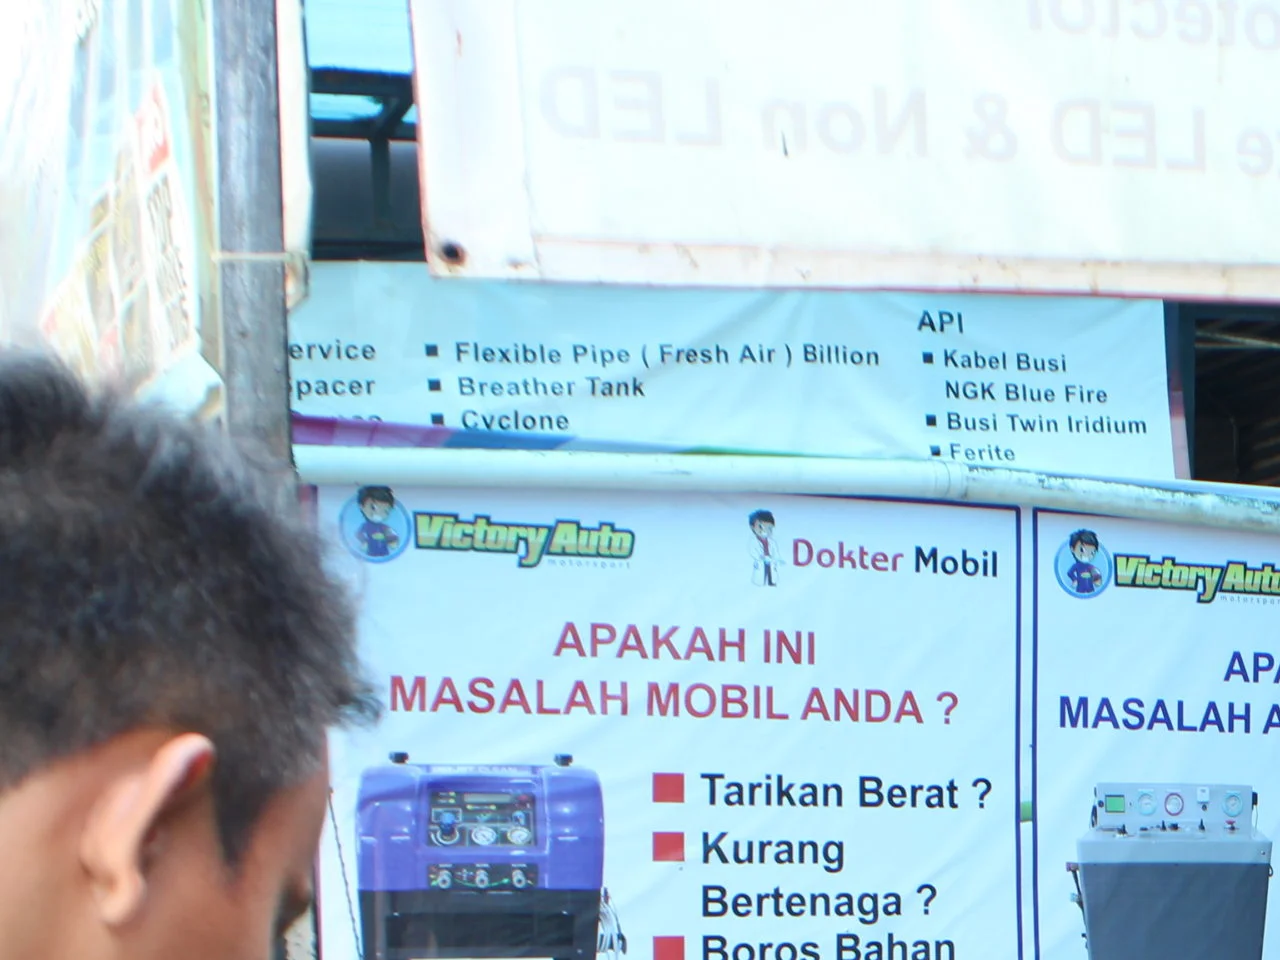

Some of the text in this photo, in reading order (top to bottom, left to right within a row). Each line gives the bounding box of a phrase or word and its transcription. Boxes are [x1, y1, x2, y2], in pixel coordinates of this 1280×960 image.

[917, 310, 964, 334] API
[288, 339, 376, 359] ervice
[455, 341, 562, 364] Flexible
[573, 344, 631, 367] Pipe
[659, 344, 729, 365] Fresh
[739, 344, 776, 365] Air
[803, 344, 880, 366] Billion
[944, 349, 1067, 373] Kabel Busi
[290, 379, 376, 401] pacer
[458, 377, 646, 397] Breather Tank
[944, 381, 1108, 404] NGK Blue Fire
[461, 410, 570, 431] Cyclone
[947, 412, 1148, 435] Busi Twin Iridium
[950, 443, 1016, 462] Ferite
[413, 510, 635, 568] Victory Auto
[792, 538, 998, 577] Dokter Mobil
[1113, 552, 1225, 604] Victory
[552, 621, 816, 665] APAKAH INI
[389, 675, 959, 725] MASALAH MOBIL ANDA ?
[1059, 695, 1251, 734] MASALAH
[700, 773, 993, 809] Tarikan Berat ?
[702, 831, 845, 873] Kurang
[702, 884, 938, 925] Bertenaga ?
